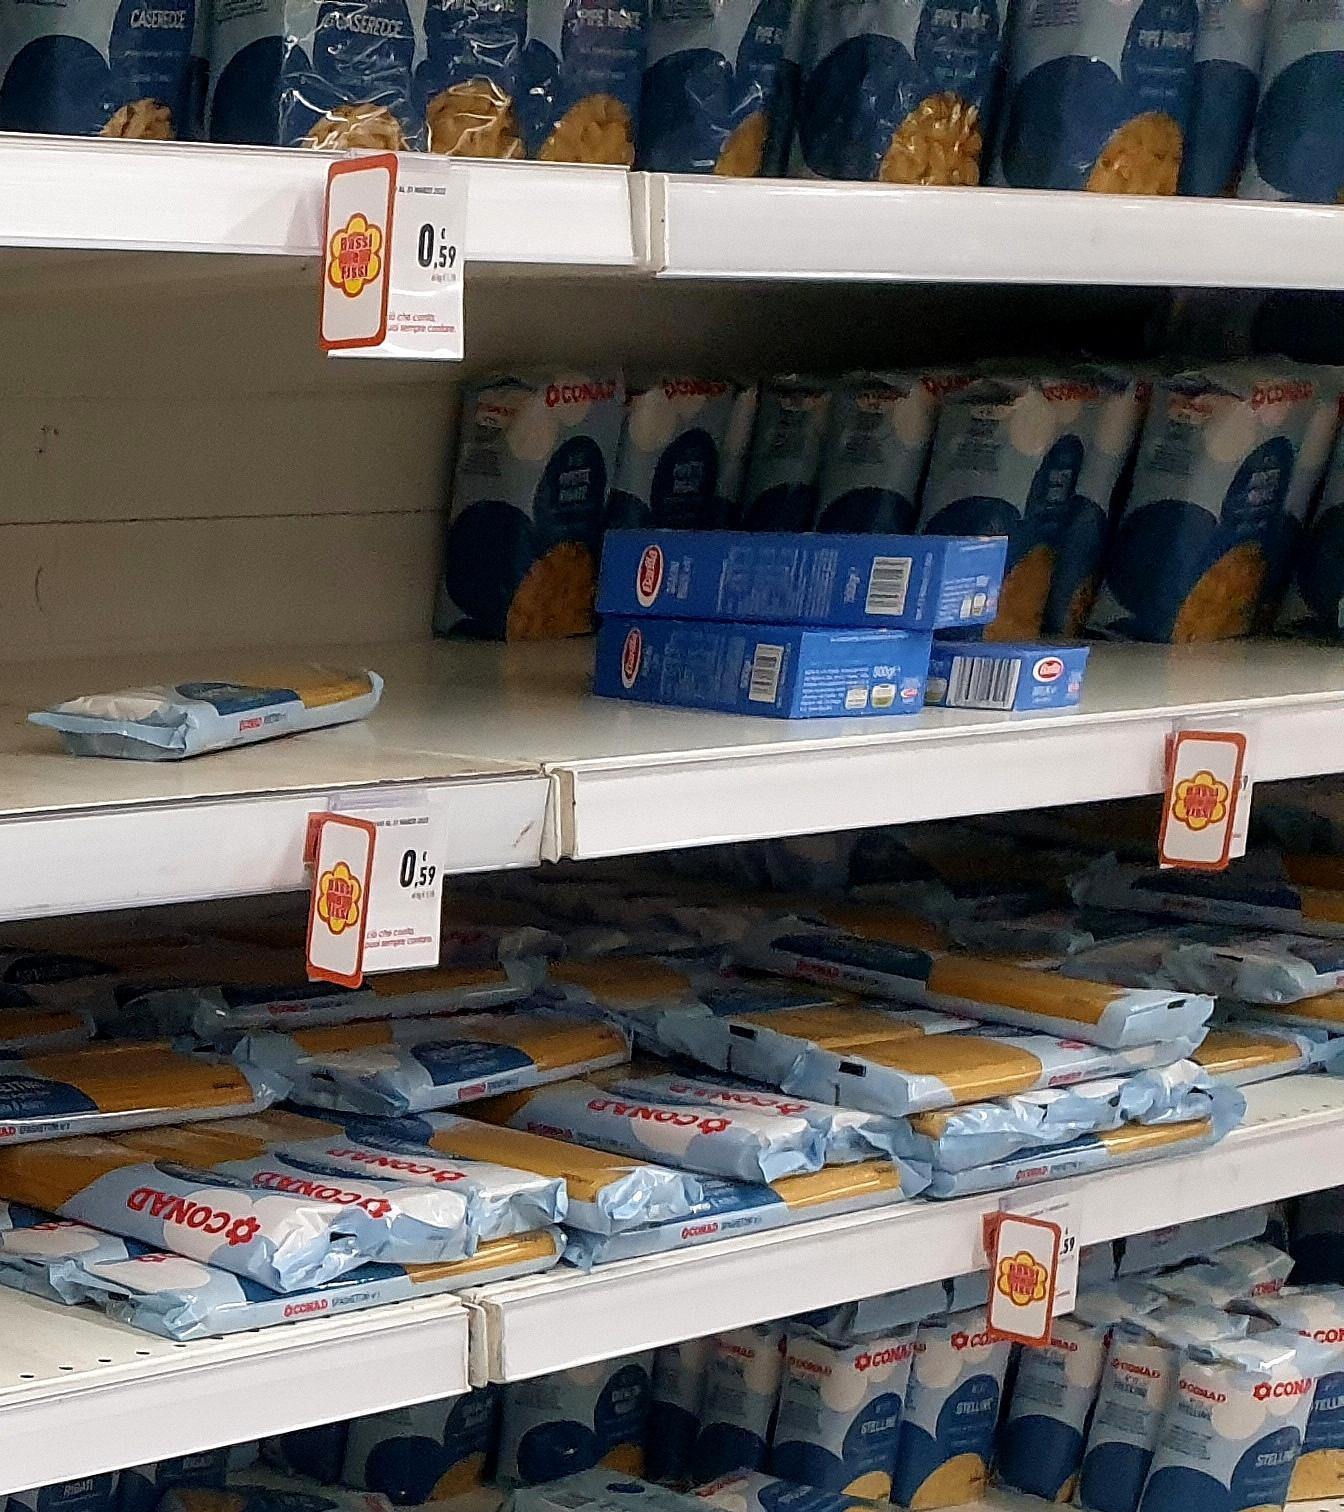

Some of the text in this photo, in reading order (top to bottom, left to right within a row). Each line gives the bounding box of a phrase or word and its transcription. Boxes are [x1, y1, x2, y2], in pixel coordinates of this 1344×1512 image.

[418, 223, 456, 269] 0,59
[400, 849, 436, 888] 0,59
[588, 1100, 699, 1126] CONAD
[251, 1171, 363, 1205] CONAD
[127, 1187, 230, 1234] CONAD
[294, 1299, 328, 1314] CONAD
